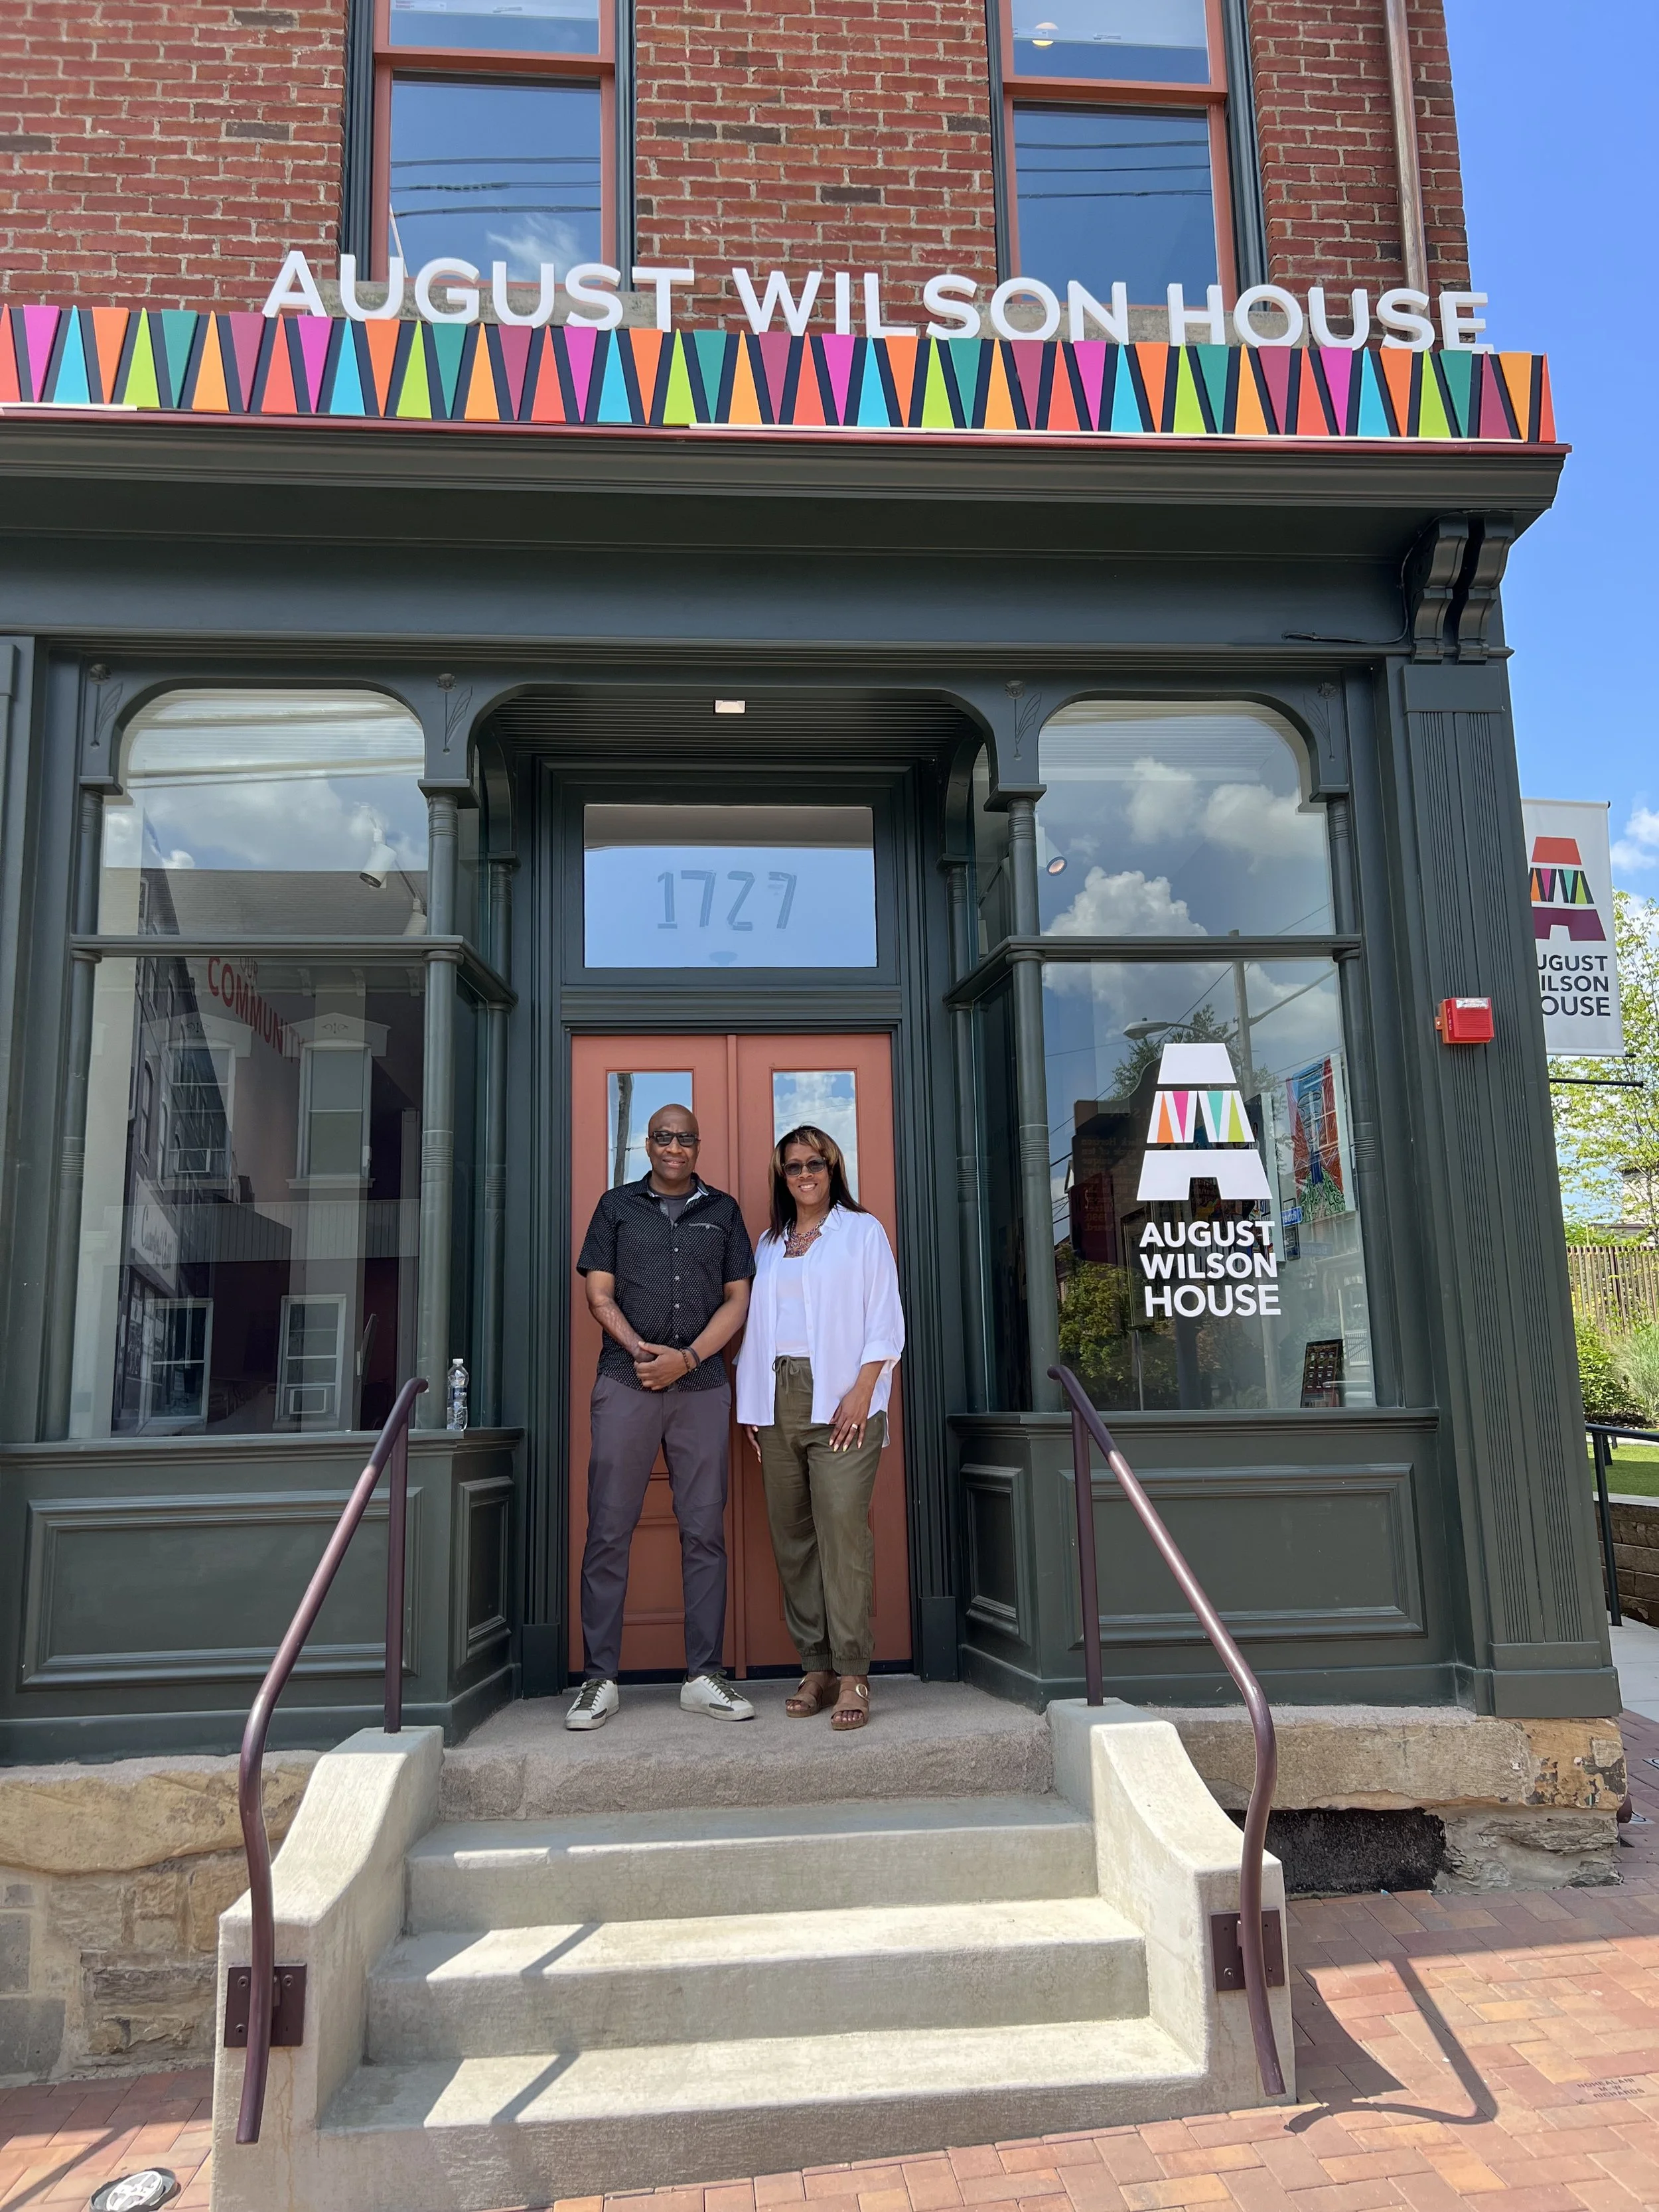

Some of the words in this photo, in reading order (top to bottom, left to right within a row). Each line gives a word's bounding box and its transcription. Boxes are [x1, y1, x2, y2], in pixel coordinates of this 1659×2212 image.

[262, 250, 695, 333] AUGUST
[732, 267, 1129, 345] WILSON
[1166, 282, 1494, 353] HOUSE
[657, 869, 797, 931] 1727
[1537, 954, 1609, 972] UGUST
[1541, 975, 1609, 992] ILSON
[1541, 995, 1611, 1016] OUSE
[1139, 1221, 1275, 1247] AUGUST
[1140, 1252, 1278, 1280] WILSON
[1145, 1284, 1281, 1317] HOUSE
